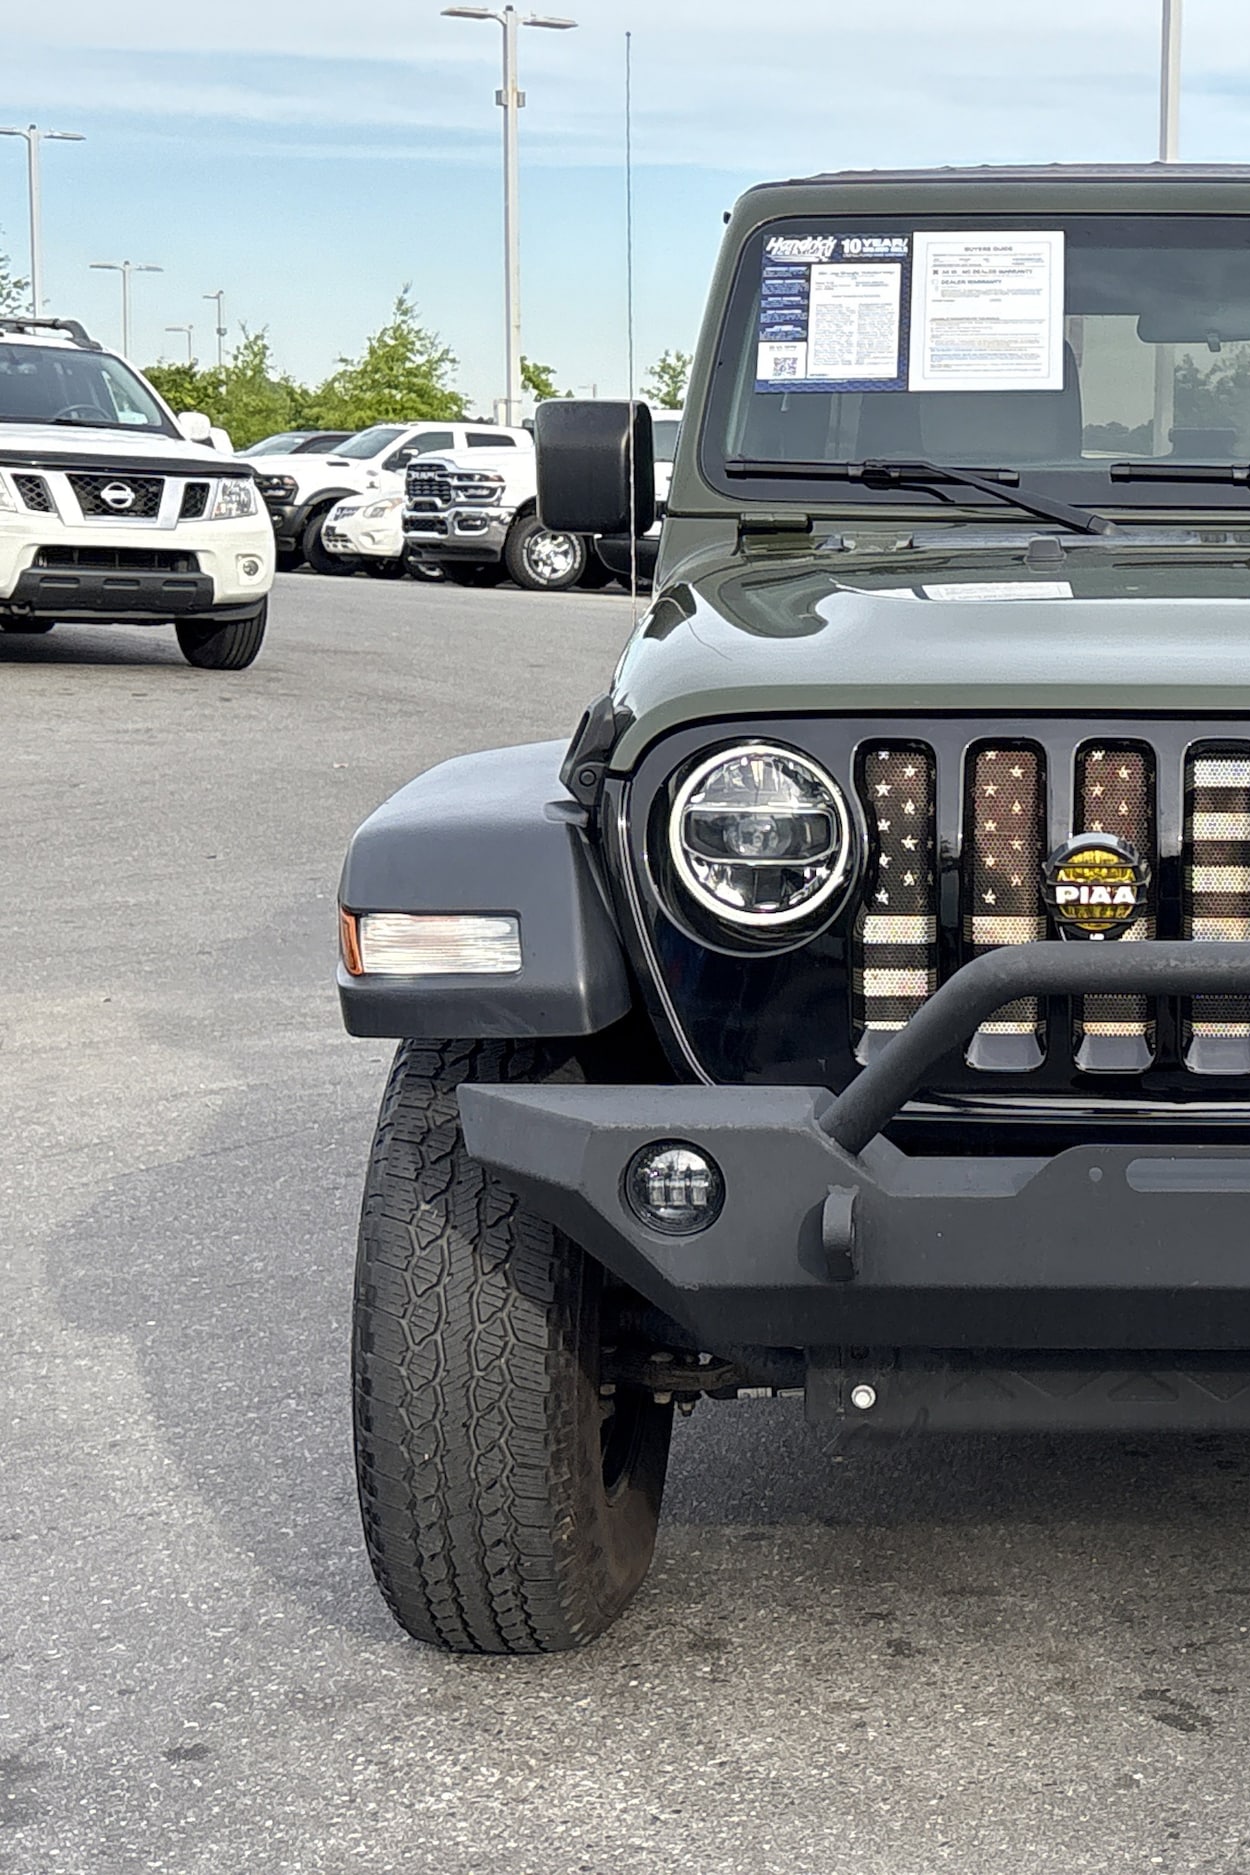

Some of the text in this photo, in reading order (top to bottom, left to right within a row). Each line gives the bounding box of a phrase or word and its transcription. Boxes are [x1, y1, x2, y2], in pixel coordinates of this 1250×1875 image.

[766, 236, 837, 257] Hendrick
[841, 238, 862, 254] 10
[1055, 885, 1136, 904] PIAA
